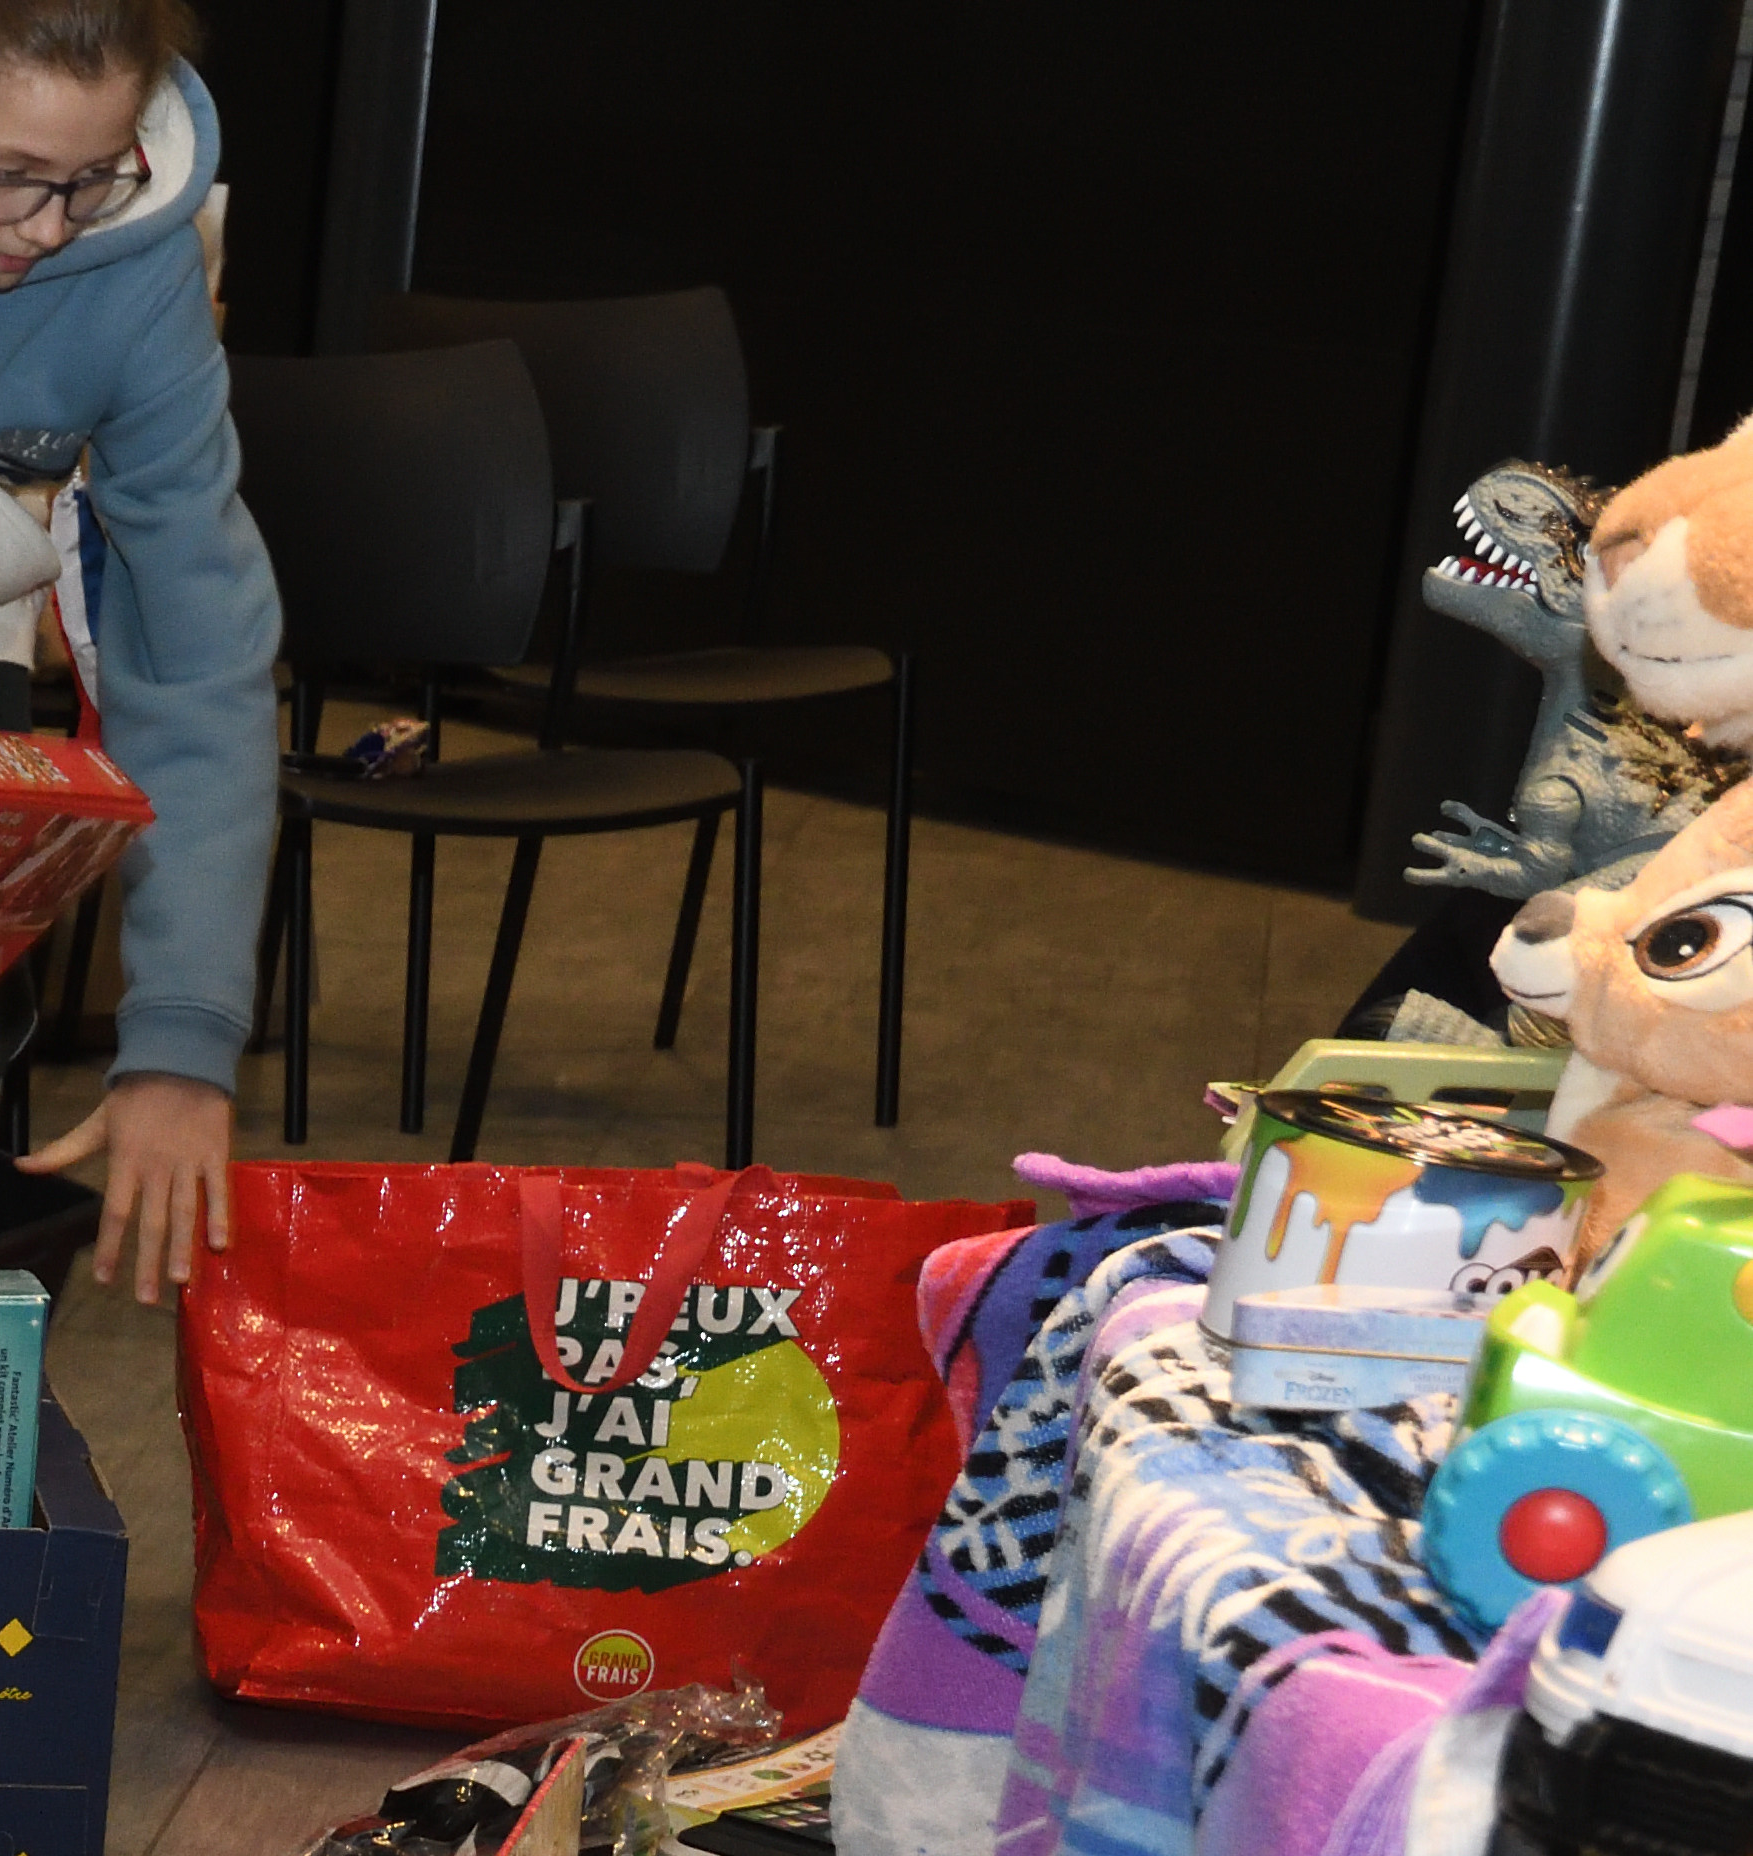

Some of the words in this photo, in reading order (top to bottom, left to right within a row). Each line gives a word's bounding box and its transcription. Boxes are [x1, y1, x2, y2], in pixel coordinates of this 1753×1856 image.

[0, 1349, 7, 1362] un
[0, 1364, 9, 1378] kit
[533, 1395, 674, 1447] J'AI
[5, 1424, 18, 1459] Atelier
[531, 1447, 789, 1511] GRAND
[526, 1500, 754, 1568] FRAIS.
[587, 1649, 643, 1669] GRAND
[585, 1665, 642, 1687] FRAIS
